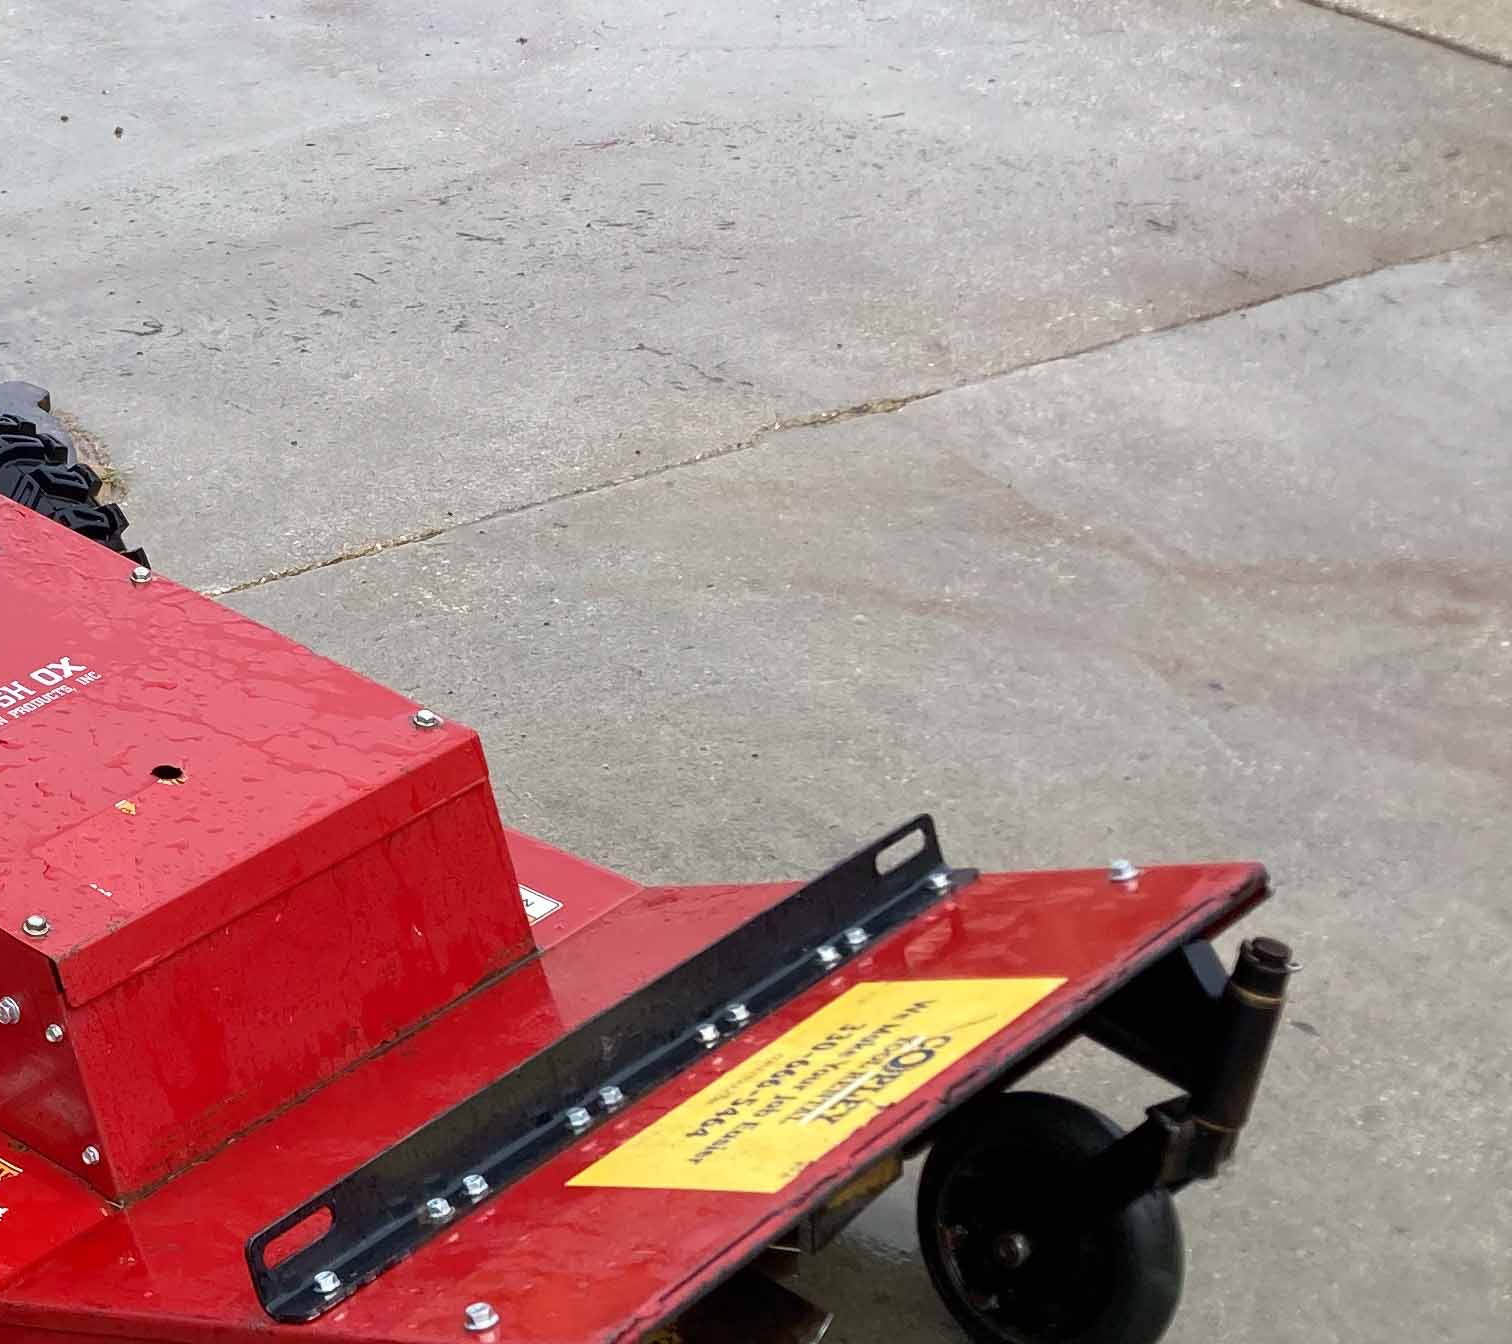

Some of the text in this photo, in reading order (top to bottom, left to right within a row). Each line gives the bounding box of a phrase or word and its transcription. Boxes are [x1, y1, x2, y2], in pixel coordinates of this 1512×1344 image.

[7, 684, 78, 719] PRODUCTS,
[75, 671, 102, 686] INC
[29, 656, 88, 686] OX
[815, 1035, 951, 1125] COPLEY
